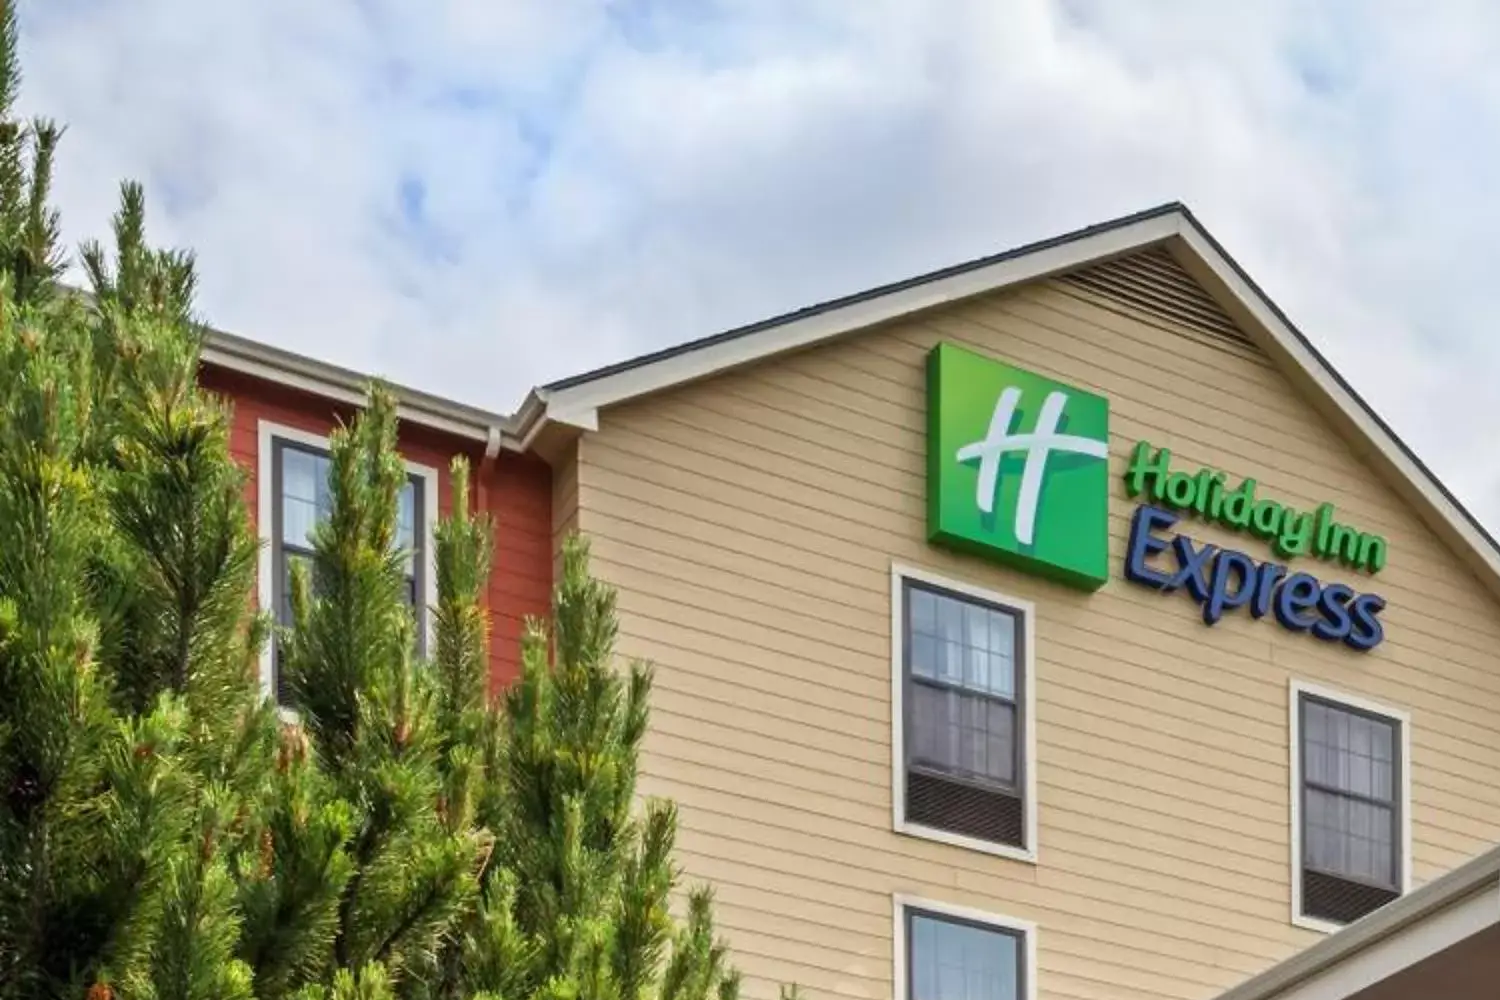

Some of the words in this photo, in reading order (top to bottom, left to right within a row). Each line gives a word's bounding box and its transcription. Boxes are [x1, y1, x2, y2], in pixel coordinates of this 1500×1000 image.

[1124, 440, 1313, 558] Holiday
[1312, 502, 1387, 574] Inn
[1124, 503, 1387, 650] Express
